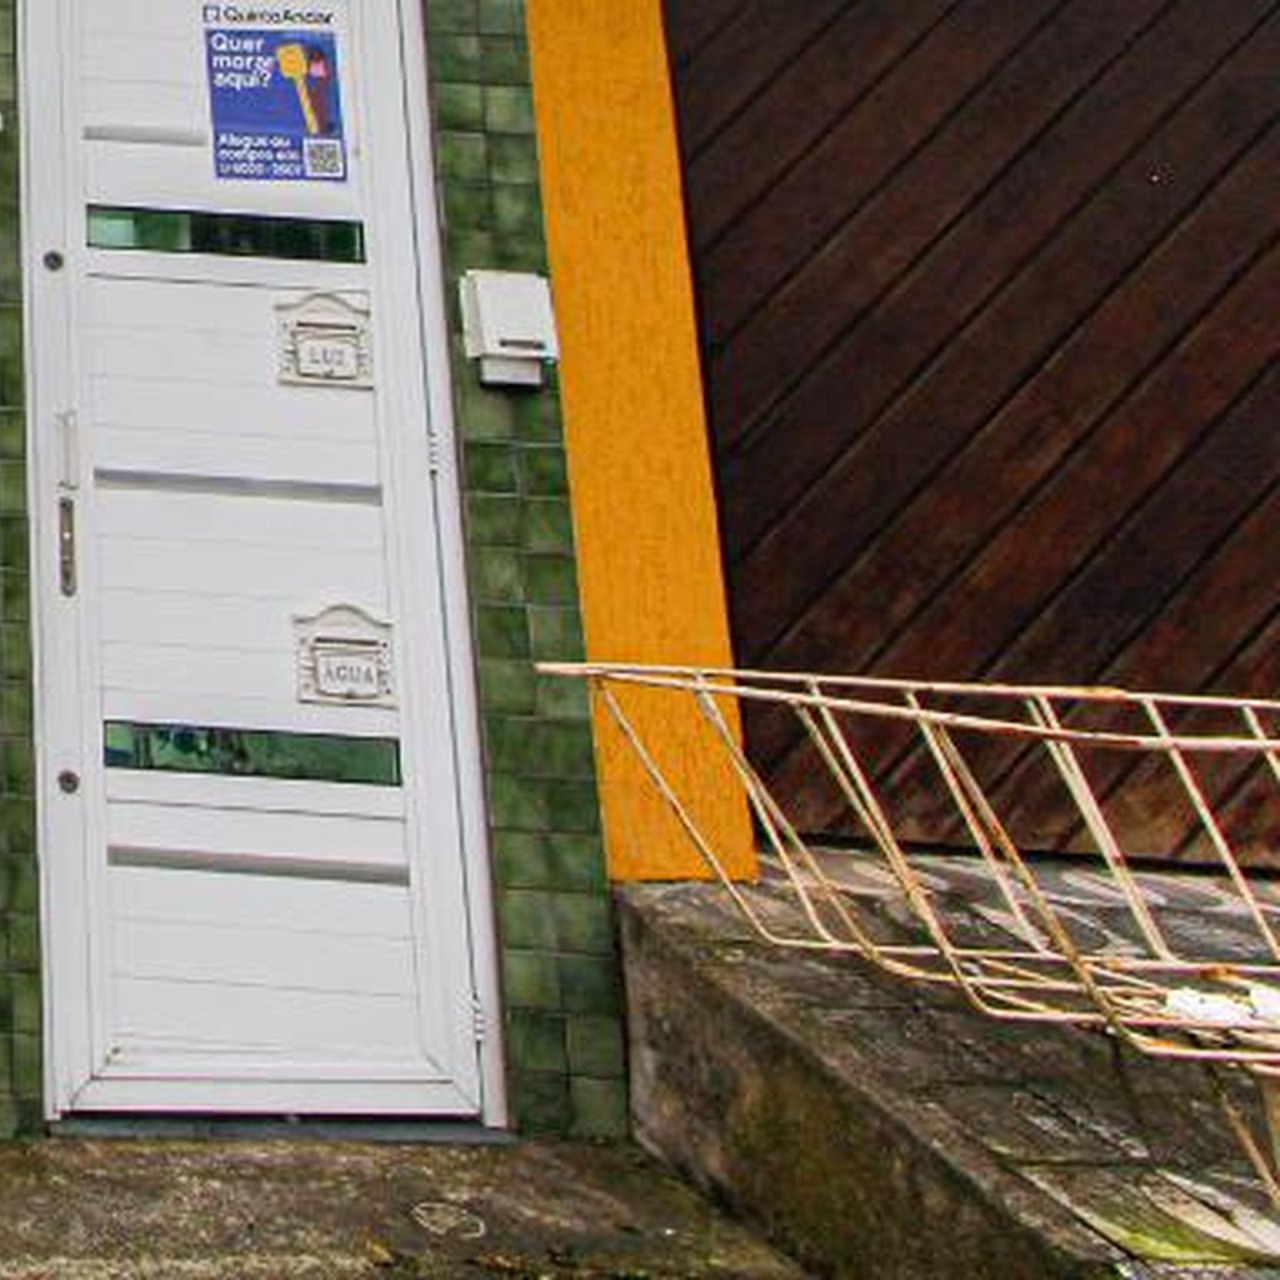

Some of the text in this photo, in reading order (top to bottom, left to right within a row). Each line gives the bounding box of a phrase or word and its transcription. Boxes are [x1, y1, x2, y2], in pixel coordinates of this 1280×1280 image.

[211, 33, 264, 52] Quer
[212, 56, 274, 71] morar
[214, 72, 271, 89] aqui?
